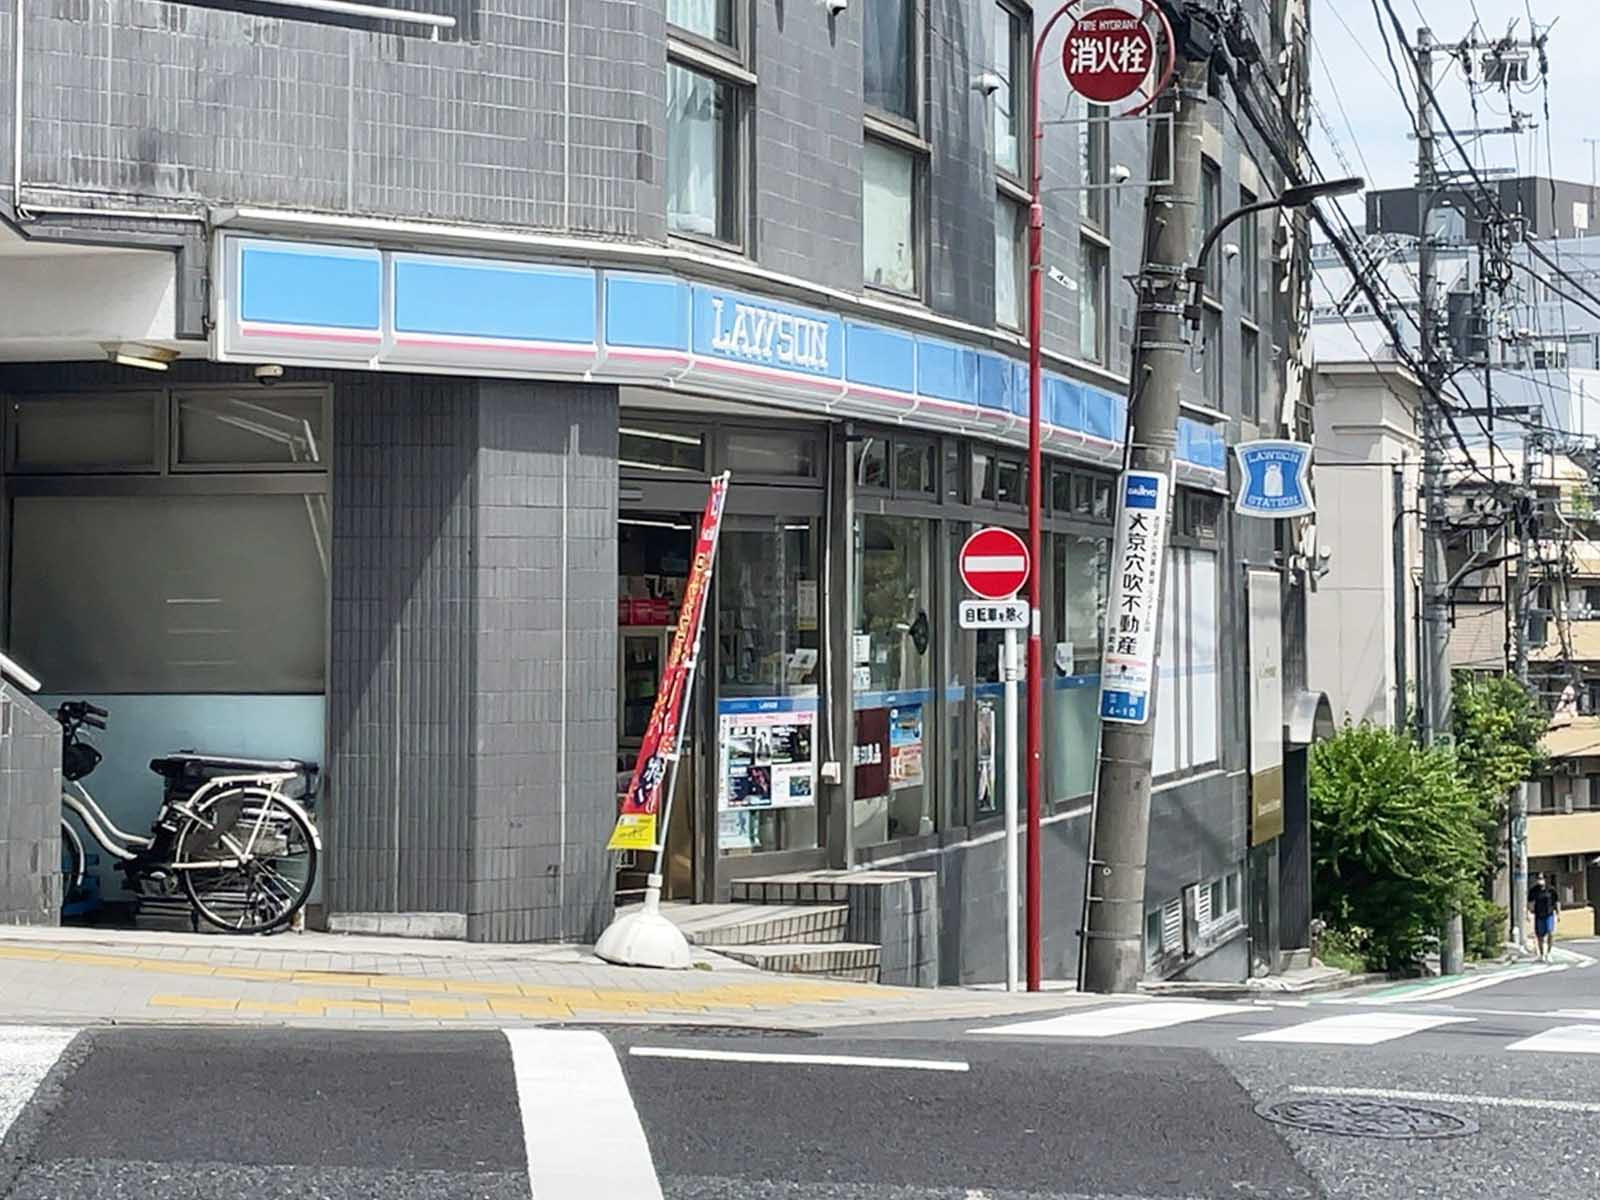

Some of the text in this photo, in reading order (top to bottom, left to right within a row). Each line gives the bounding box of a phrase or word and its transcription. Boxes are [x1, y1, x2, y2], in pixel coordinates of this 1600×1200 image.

[1078, 20, 1138, 30] FIRE HYDRANT
[1070, 36, 1147, 74] 消火栓
[712, 298, 829, 369] LAWSON
[1247, 451, 1300, 463] LAWSON
[1247, 495, 1300, 507] STATION
[1116, 512, 1149, 655] 大京穴吹不動産
[965, 606, 1024, 623] 自転車を除く
